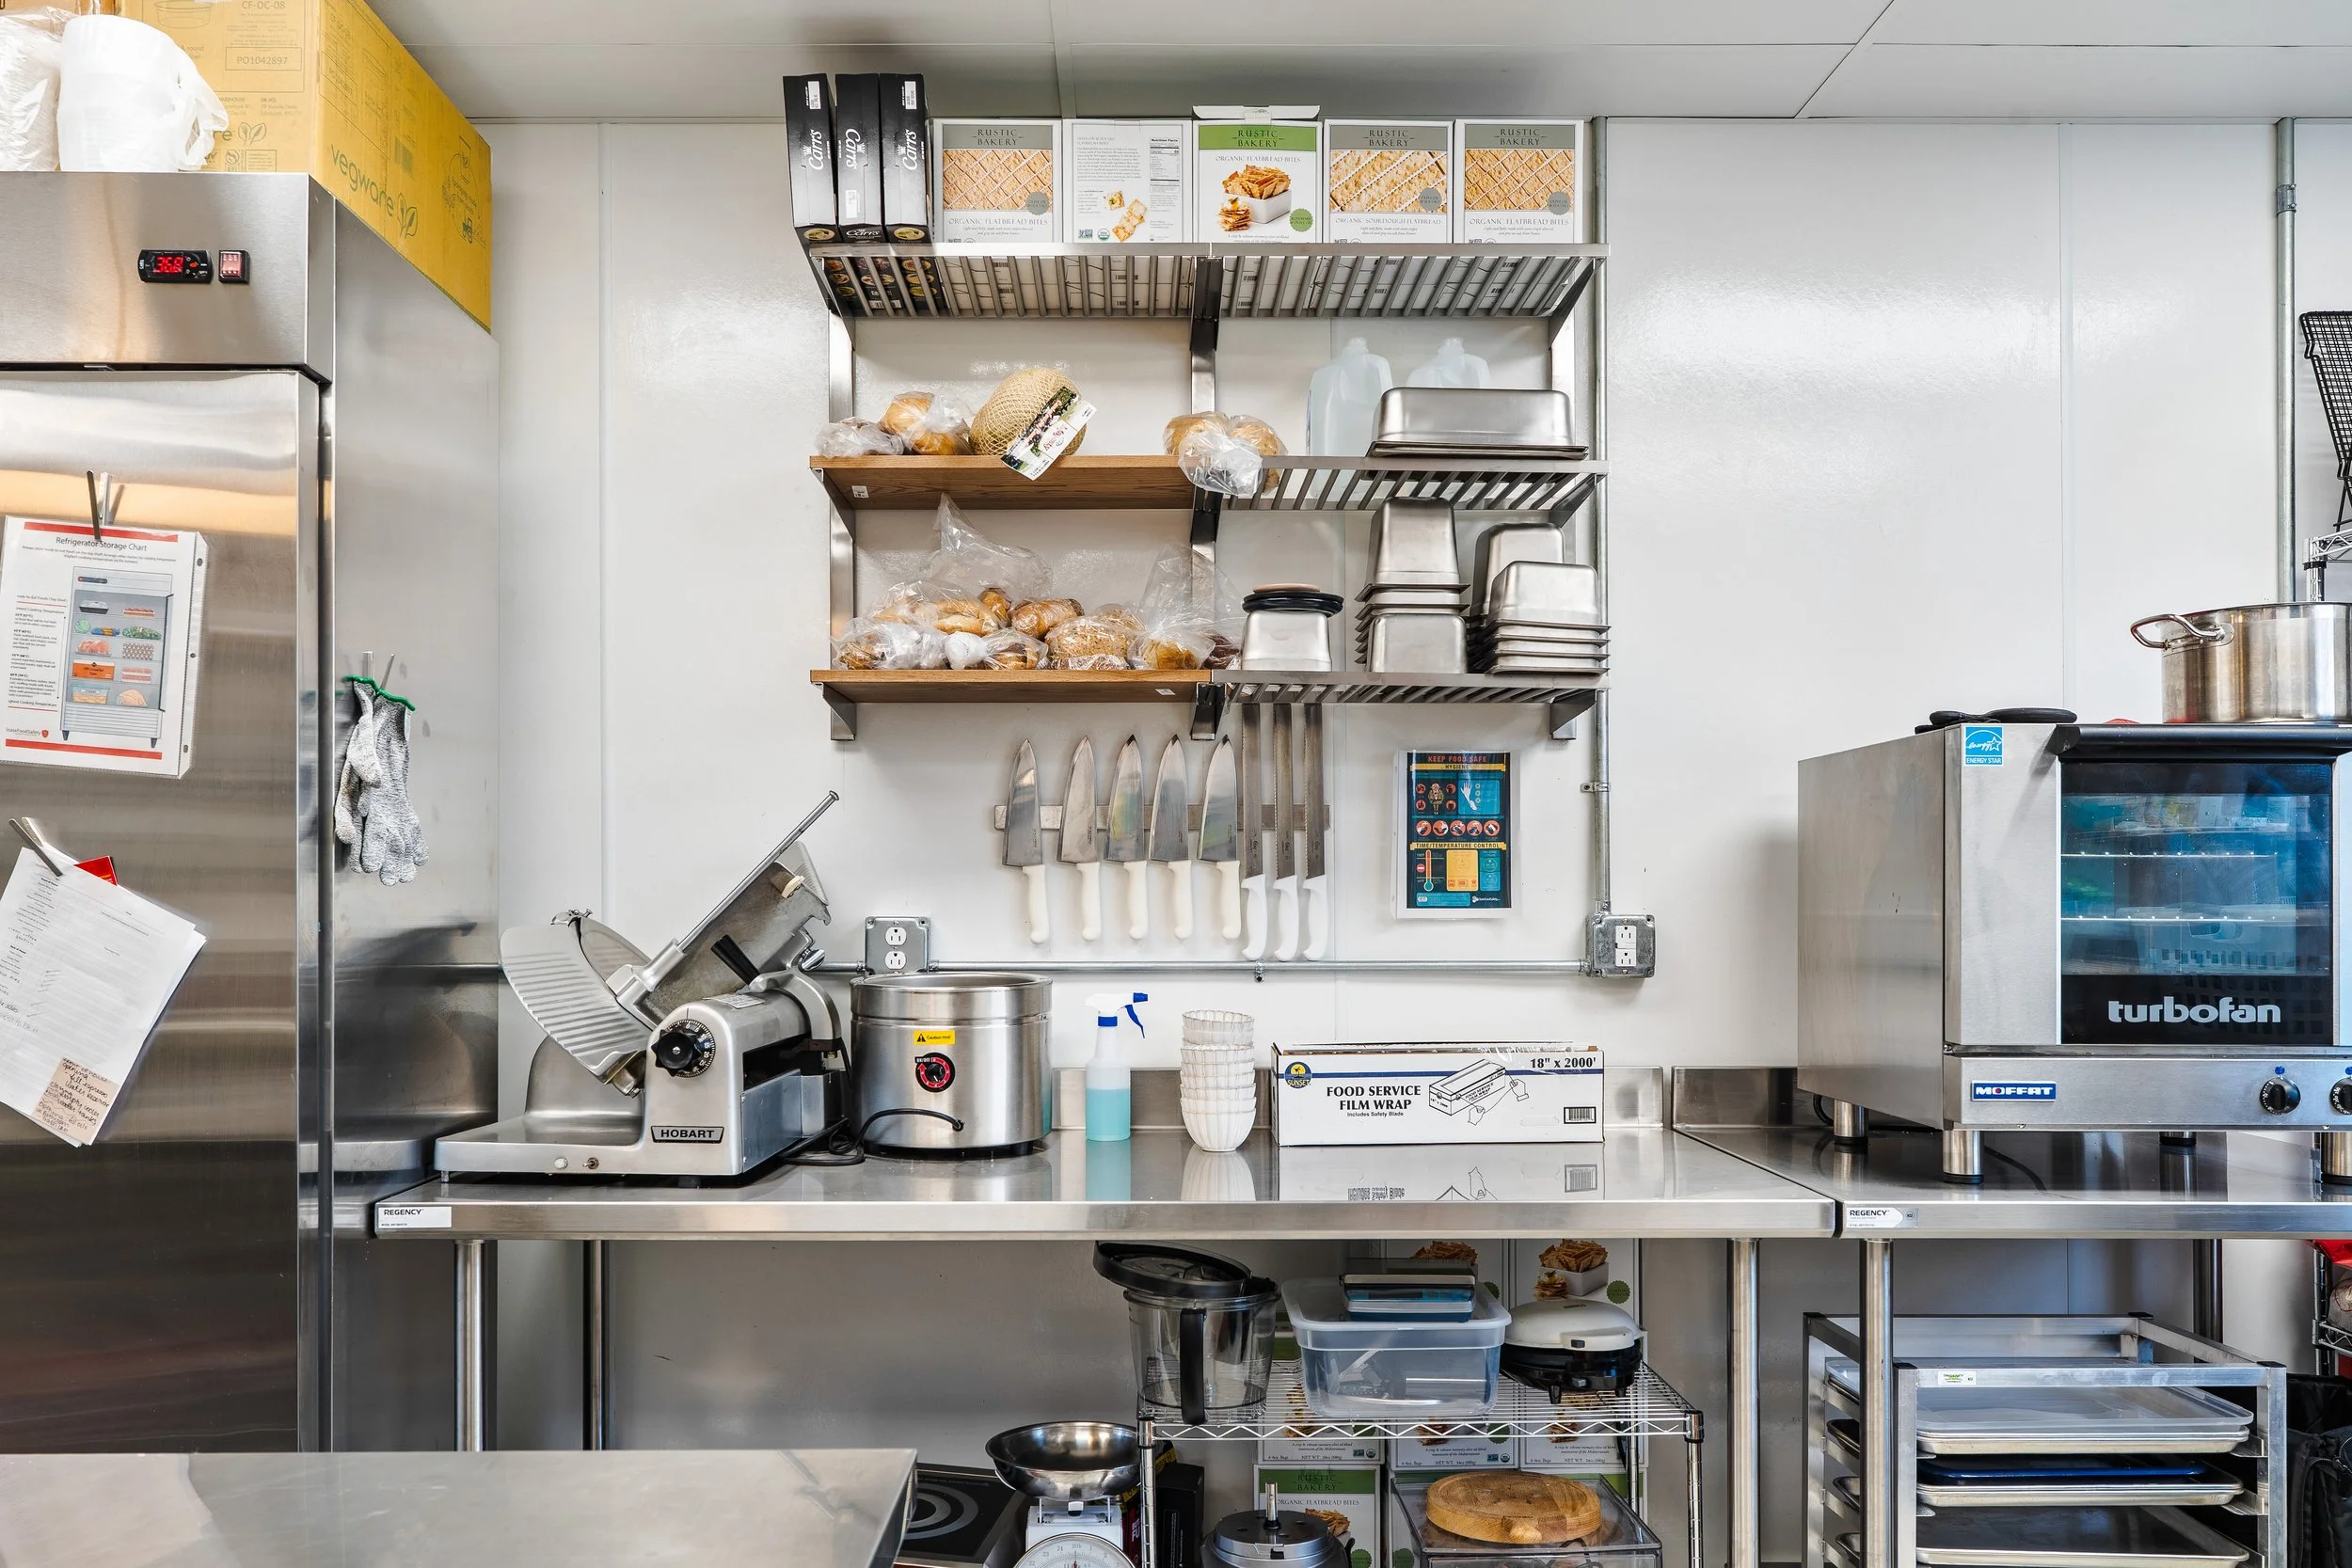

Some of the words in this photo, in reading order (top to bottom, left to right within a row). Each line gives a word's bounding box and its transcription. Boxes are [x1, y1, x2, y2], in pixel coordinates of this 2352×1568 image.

[242, 1, 286, 9] CF-DC-08
[809, 128, 823, 170] Carr's
[845, 128, 860, 170] Carr's
[903, 128, 918, 171] Carr's
[331, 144, 394, 217] vegware
[56, 537, 98, 548] Refrigerator
[100, 540, 127, 551] Storage
[128, 543, 147, 551] Chart
[2108, 996, 2281, 1023] turbofan
[1530, 1058, 1550, 1069] 18"
[1564, 1057, 1597, 1068] 2000'
[1327, 1086, 1364, 1097] FOOD
[1369, 1085, 1421, 1096] SERVICE
[1975, 1087, 2053, 1095] MOFFAT
[1340, 1100, 1369, 1110] FILM
[1374, 1099, 1412, 1110] WRAP
[661, 1129, 715, 1138] HOBART
